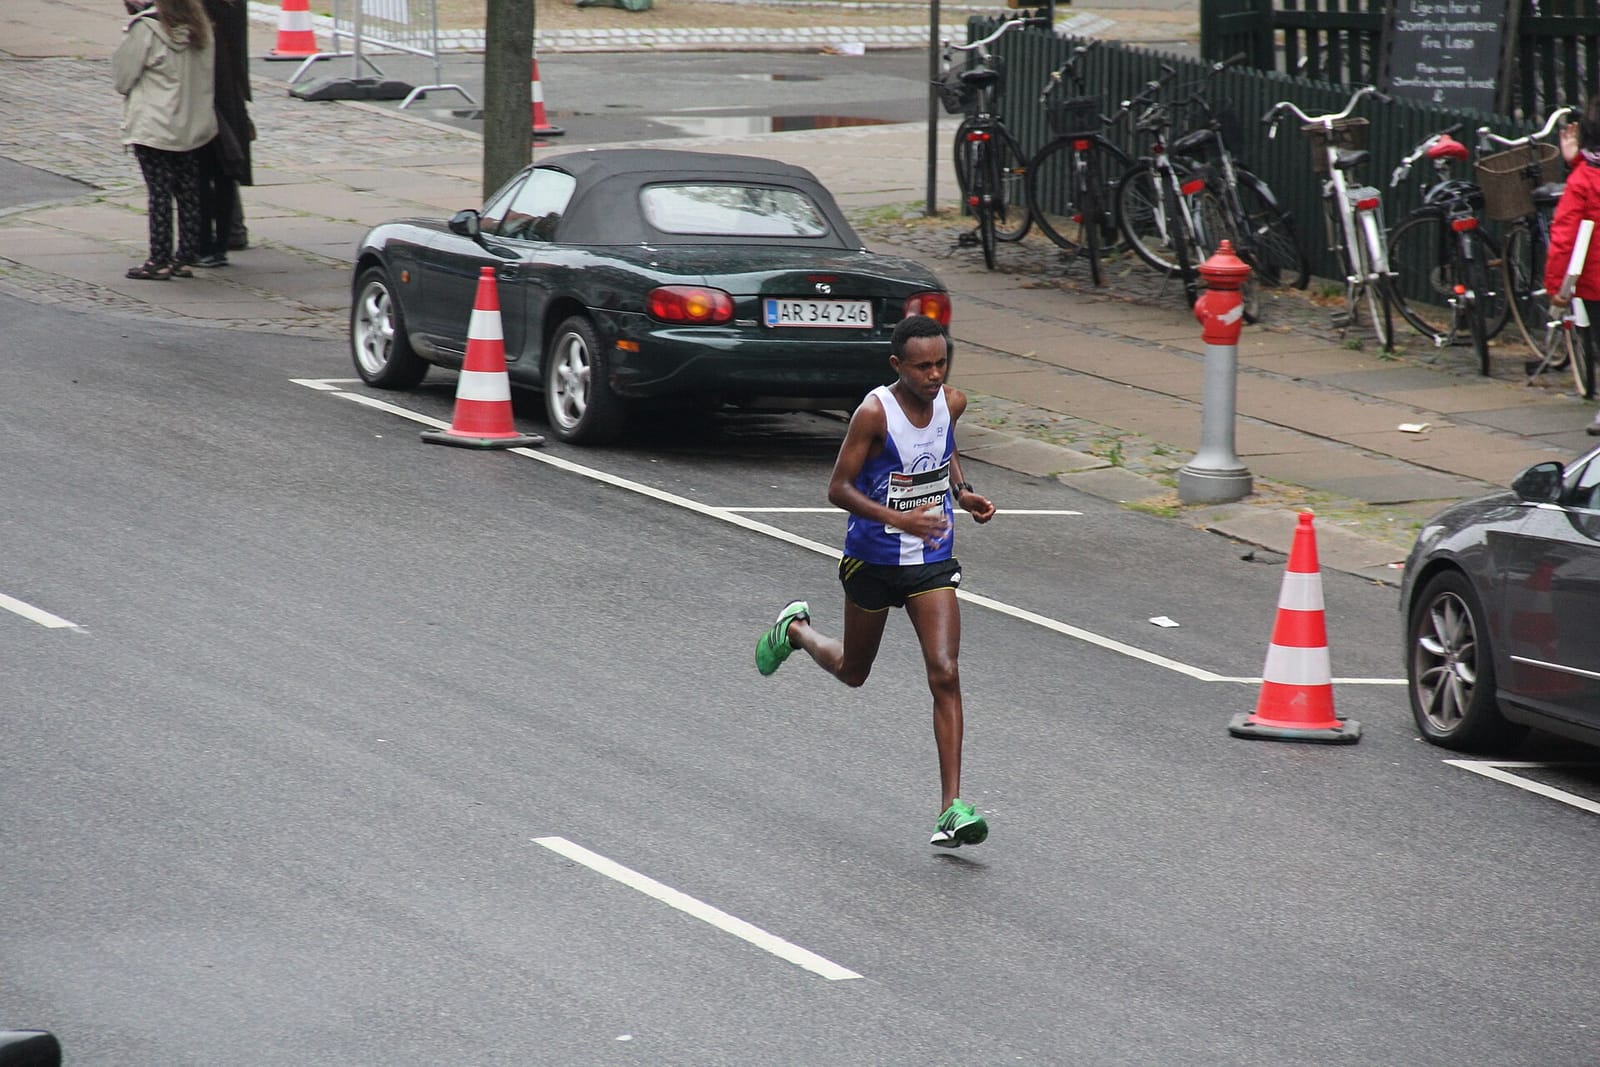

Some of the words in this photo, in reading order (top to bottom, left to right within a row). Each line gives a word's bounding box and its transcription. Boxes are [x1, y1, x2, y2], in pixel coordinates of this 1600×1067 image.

[781, 304, 804, 321] AR
[809, 304, 830, 321] 34
[836, 304, 869, 322] 246
